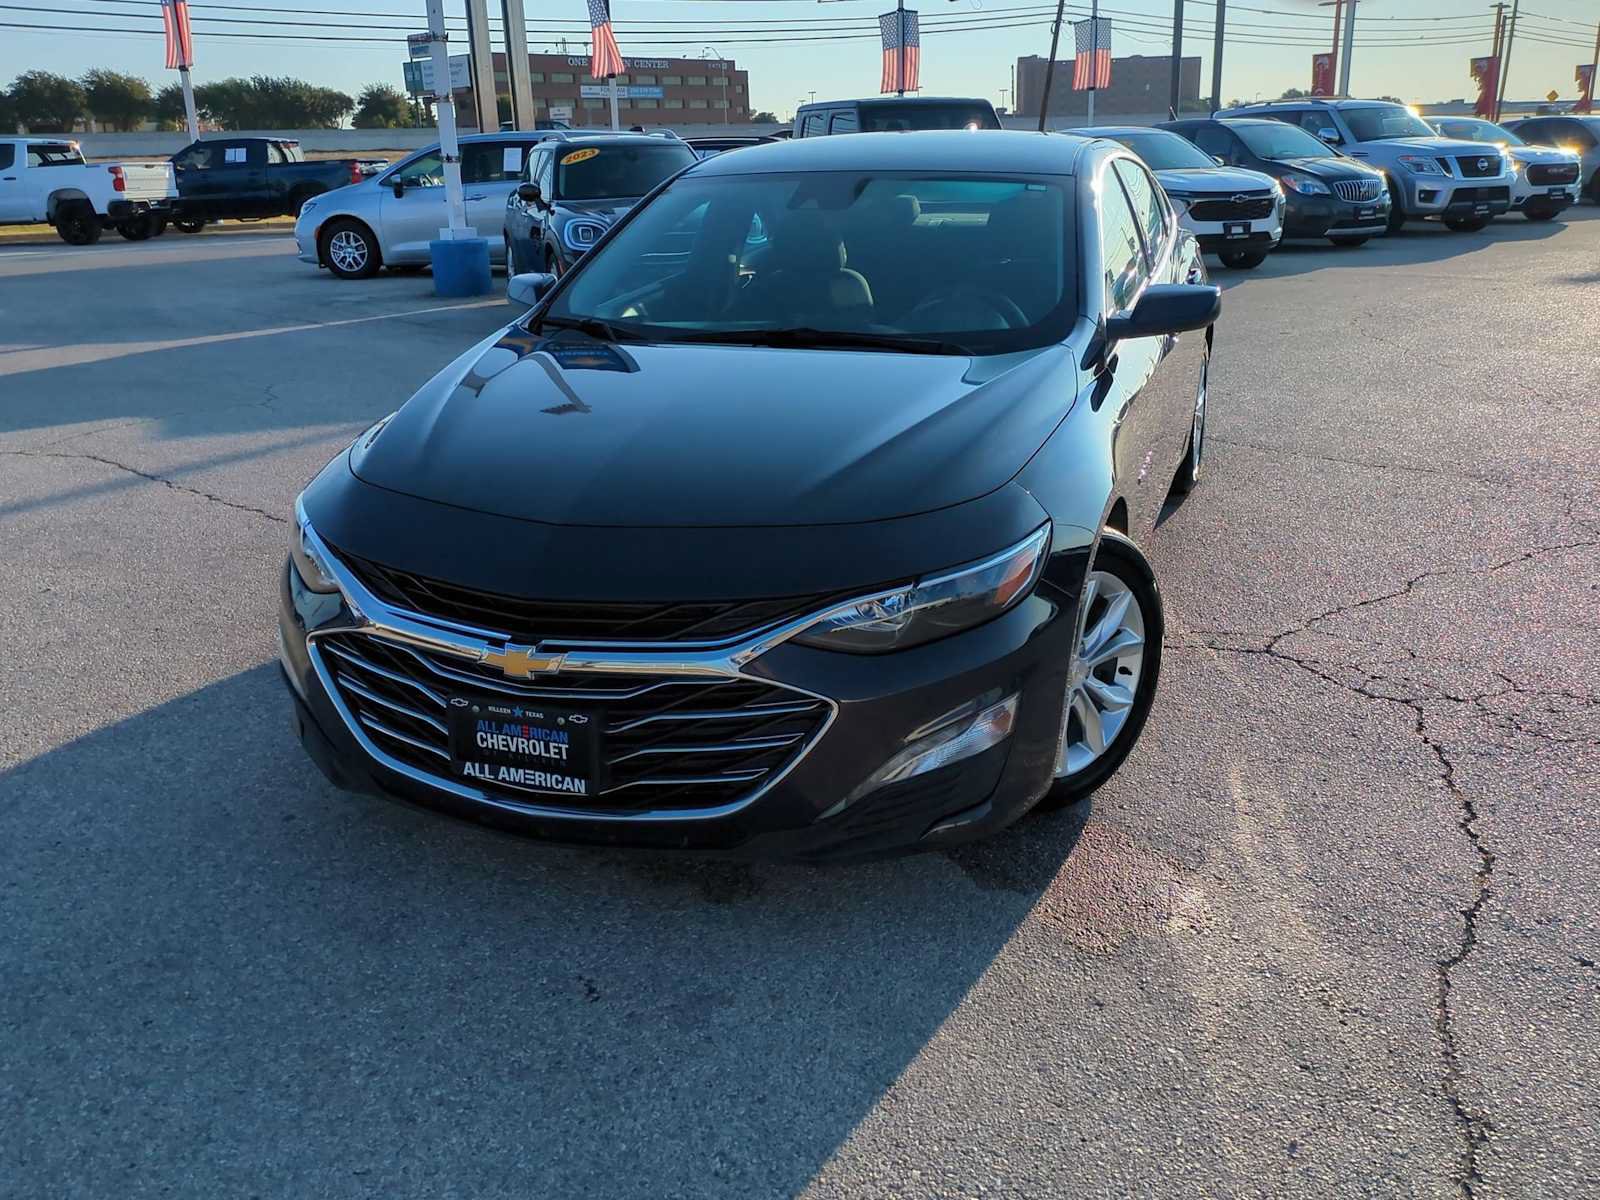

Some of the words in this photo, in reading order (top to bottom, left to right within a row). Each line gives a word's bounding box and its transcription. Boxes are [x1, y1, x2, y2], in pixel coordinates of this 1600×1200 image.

[568, 57, 588, 66] ONE
[634, 59, 670, 69] CENTER
[566, 149, 596, 164] 2023
[525, 710, 544, 719] TEXAS
[476, 719, 499, 734] ALL
[502, 722, 569, 743] AMERICAN
[476, 731, 569, 760] CHEVROLET
[463, 761, 495, 780] ALL
[497, 766, 586, 794] AMERICAN
